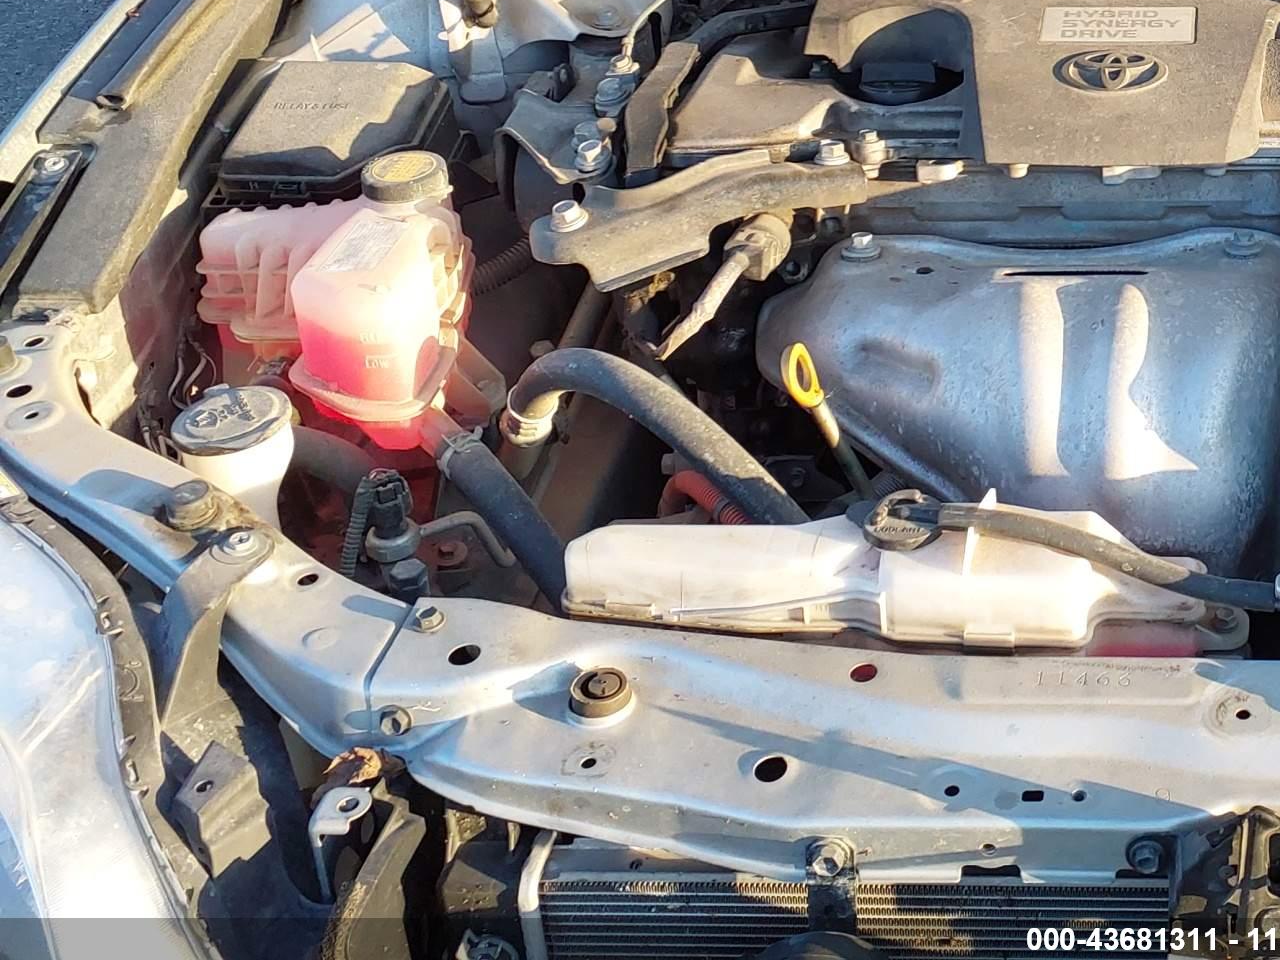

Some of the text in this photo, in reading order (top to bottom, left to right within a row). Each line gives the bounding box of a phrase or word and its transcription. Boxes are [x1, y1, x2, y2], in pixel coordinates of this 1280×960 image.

[1063, 10, 1159, 18] HYBRID
[1061, 19, 1180, 28] SYNERGY
[1060, 29, 1137, 38] DRIVE
